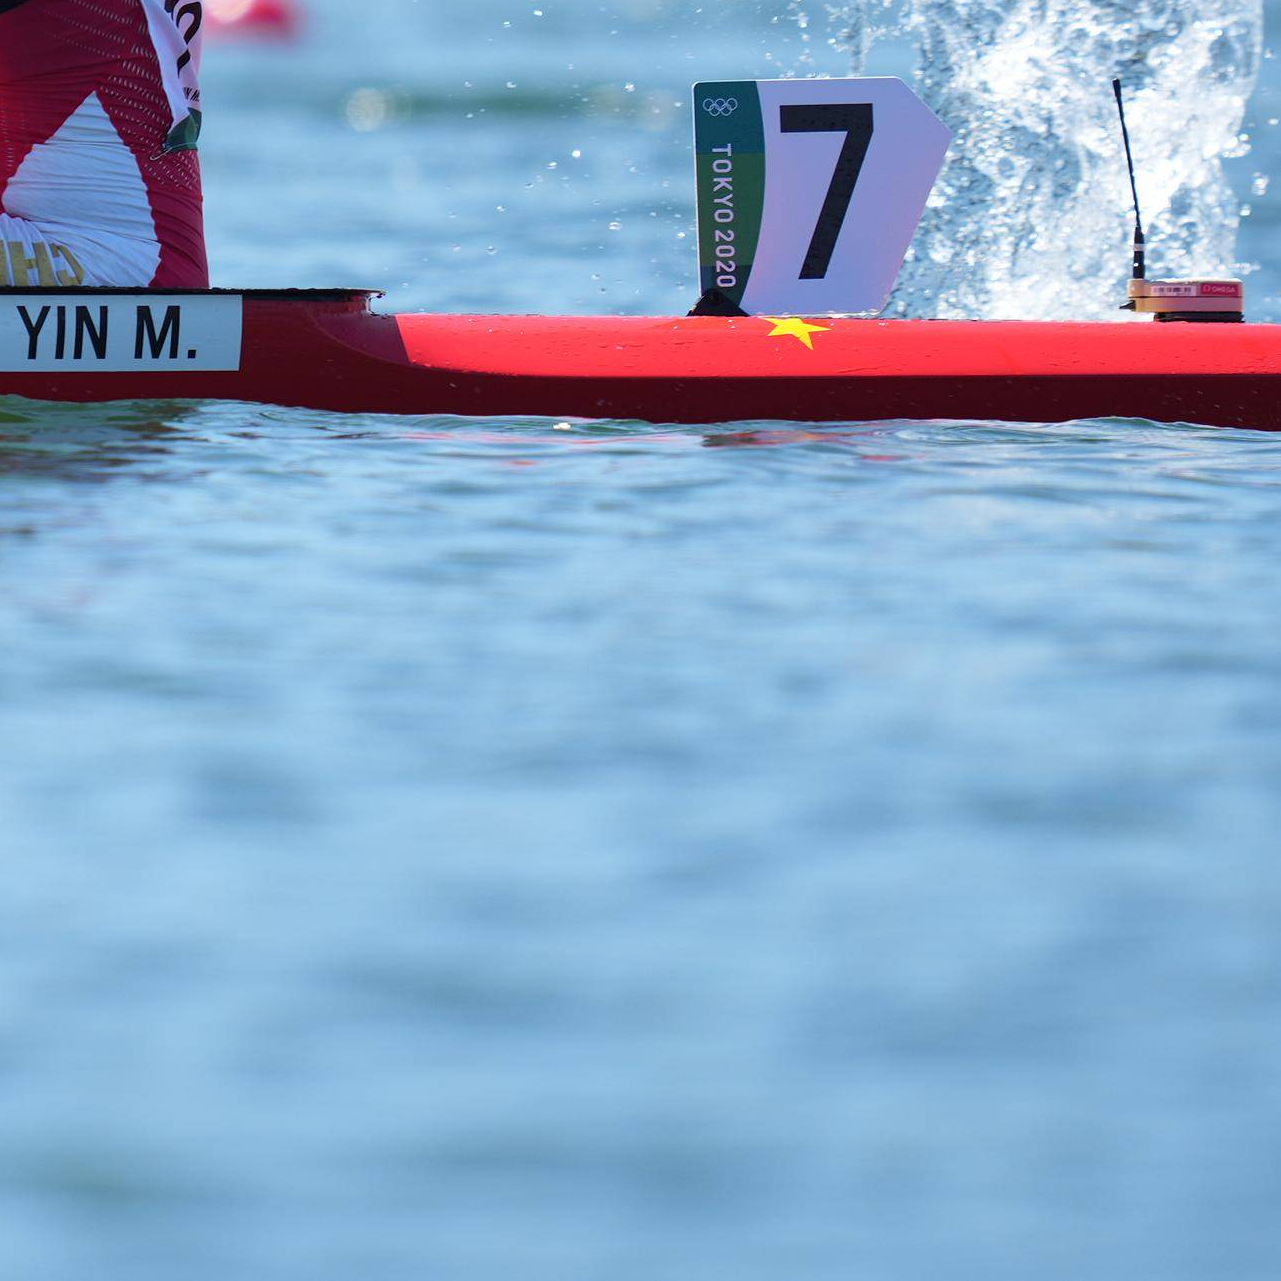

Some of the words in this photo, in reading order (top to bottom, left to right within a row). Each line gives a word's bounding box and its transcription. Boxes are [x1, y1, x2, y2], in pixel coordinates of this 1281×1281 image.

[711, 143, 735, 224] TOKYO
[779, 103, 873, 280] 7
[713, 228, 737, 288] 2020
[16, 305, 108, 360] YIN
[133, 305, 197, 360] M.
